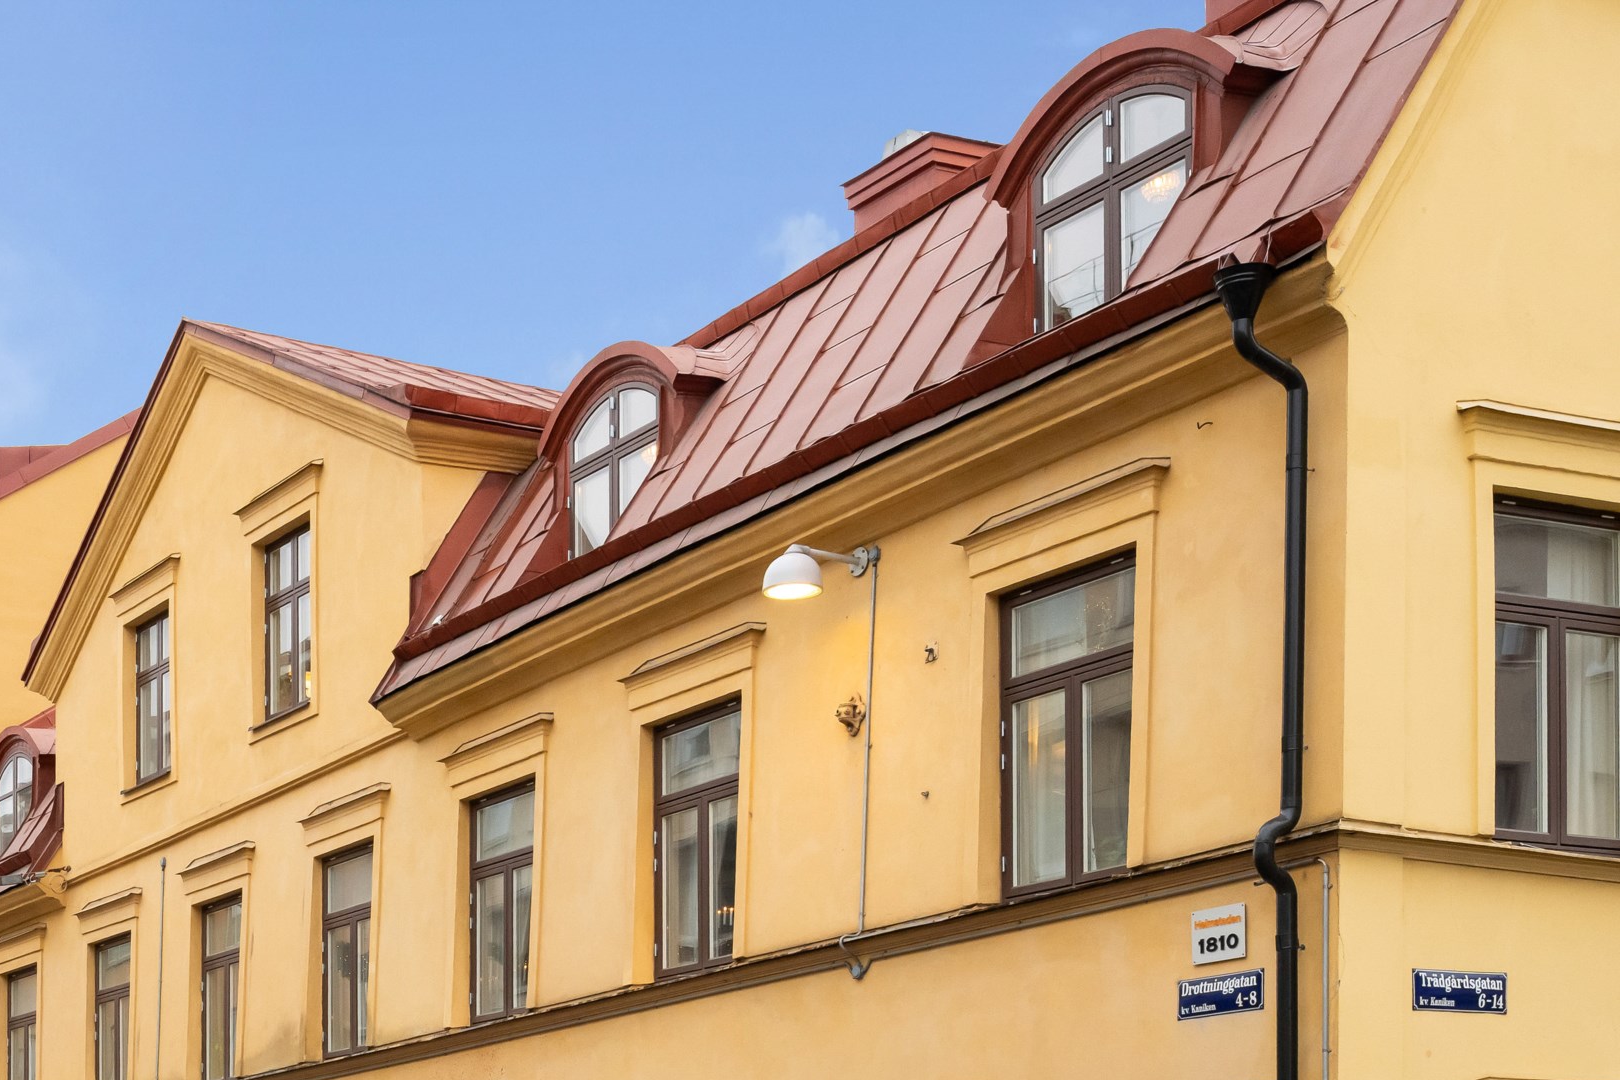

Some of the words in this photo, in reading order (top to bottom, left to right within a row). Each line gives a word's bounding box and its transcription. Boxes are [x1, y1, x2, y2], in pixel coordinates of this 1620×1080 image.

[1198, 933, 1239, 954] 1810
[1181, 975, 1257, 997] Drottninggatan
[1419, 972, 1503, 994] Trädgårdsgatan
[1235, 990, 1257, 1007] 4-8
[1478, 993, 1504, 1009] 6-14
